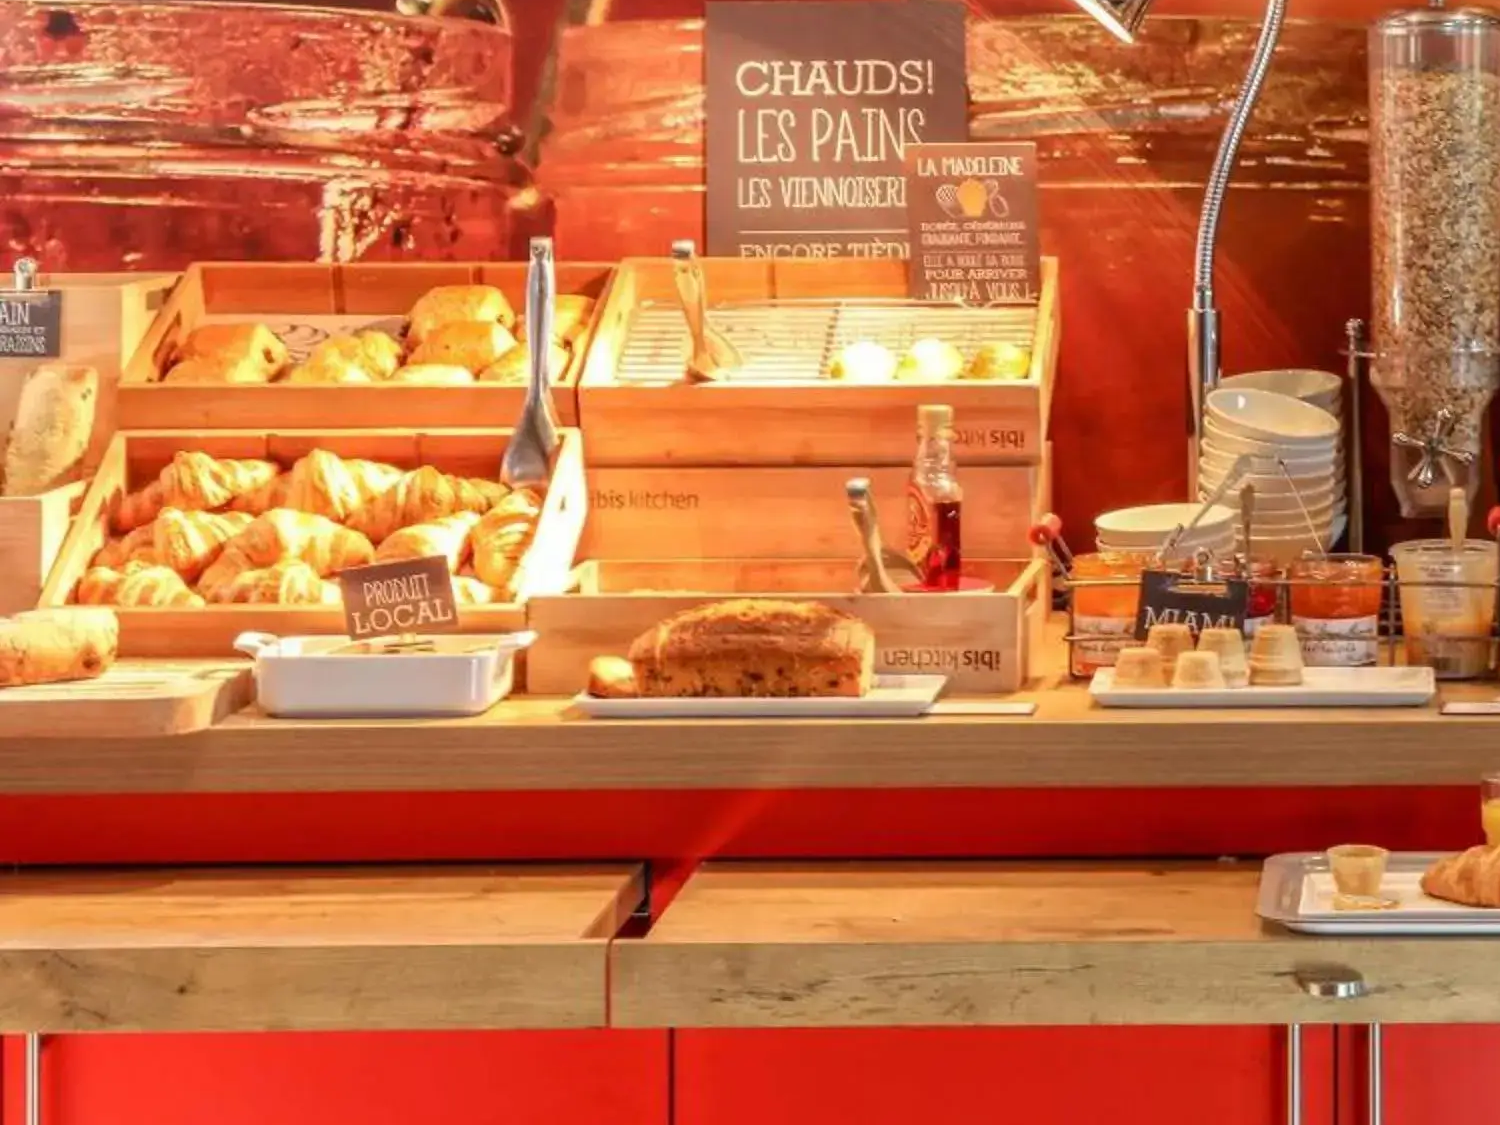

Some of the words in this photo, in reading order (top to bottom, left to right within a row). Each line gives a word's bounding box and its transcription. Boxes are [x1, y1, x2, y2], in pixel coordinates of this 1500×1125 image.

[735, 59, 935, 96] CHAUDS!
[738, 108, 797, 164] LES
[811, 107, 926, 164] PAINS
[916, 156, 939, 176] LA
[737, 176, 772, 209] LES
[989, 429, 1025, 449] ibis
[628, 489, 699, 510] kitchen
[362, 573, 430, 608] PRODUIT
[351, 598, 454, 634] LOCAL
[884, 650, 959, 670] kitchen
[962, 650, 1001, 671] ibis
